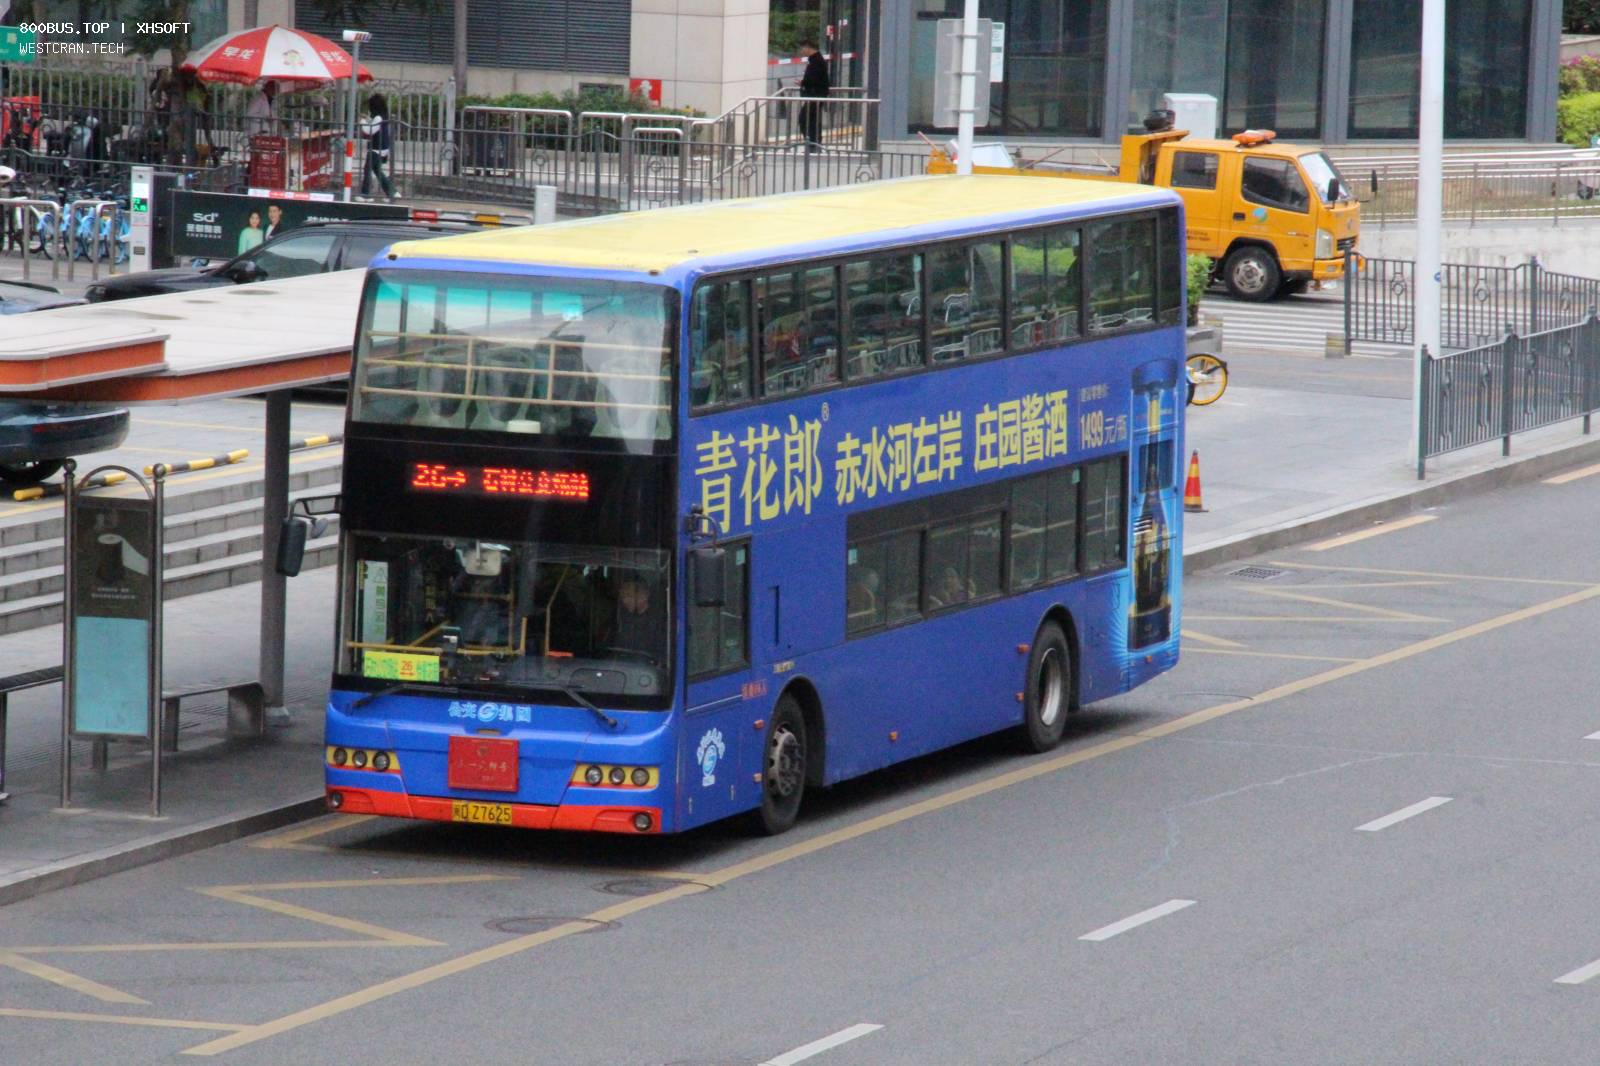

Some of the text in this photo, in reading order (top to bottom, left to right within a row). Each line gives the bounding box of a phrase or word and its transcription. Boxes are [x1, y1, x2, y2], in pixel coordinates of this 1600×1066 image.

[695, 389, 1068, 534] 青花郎 赤水河左岸 庄园酱酒
